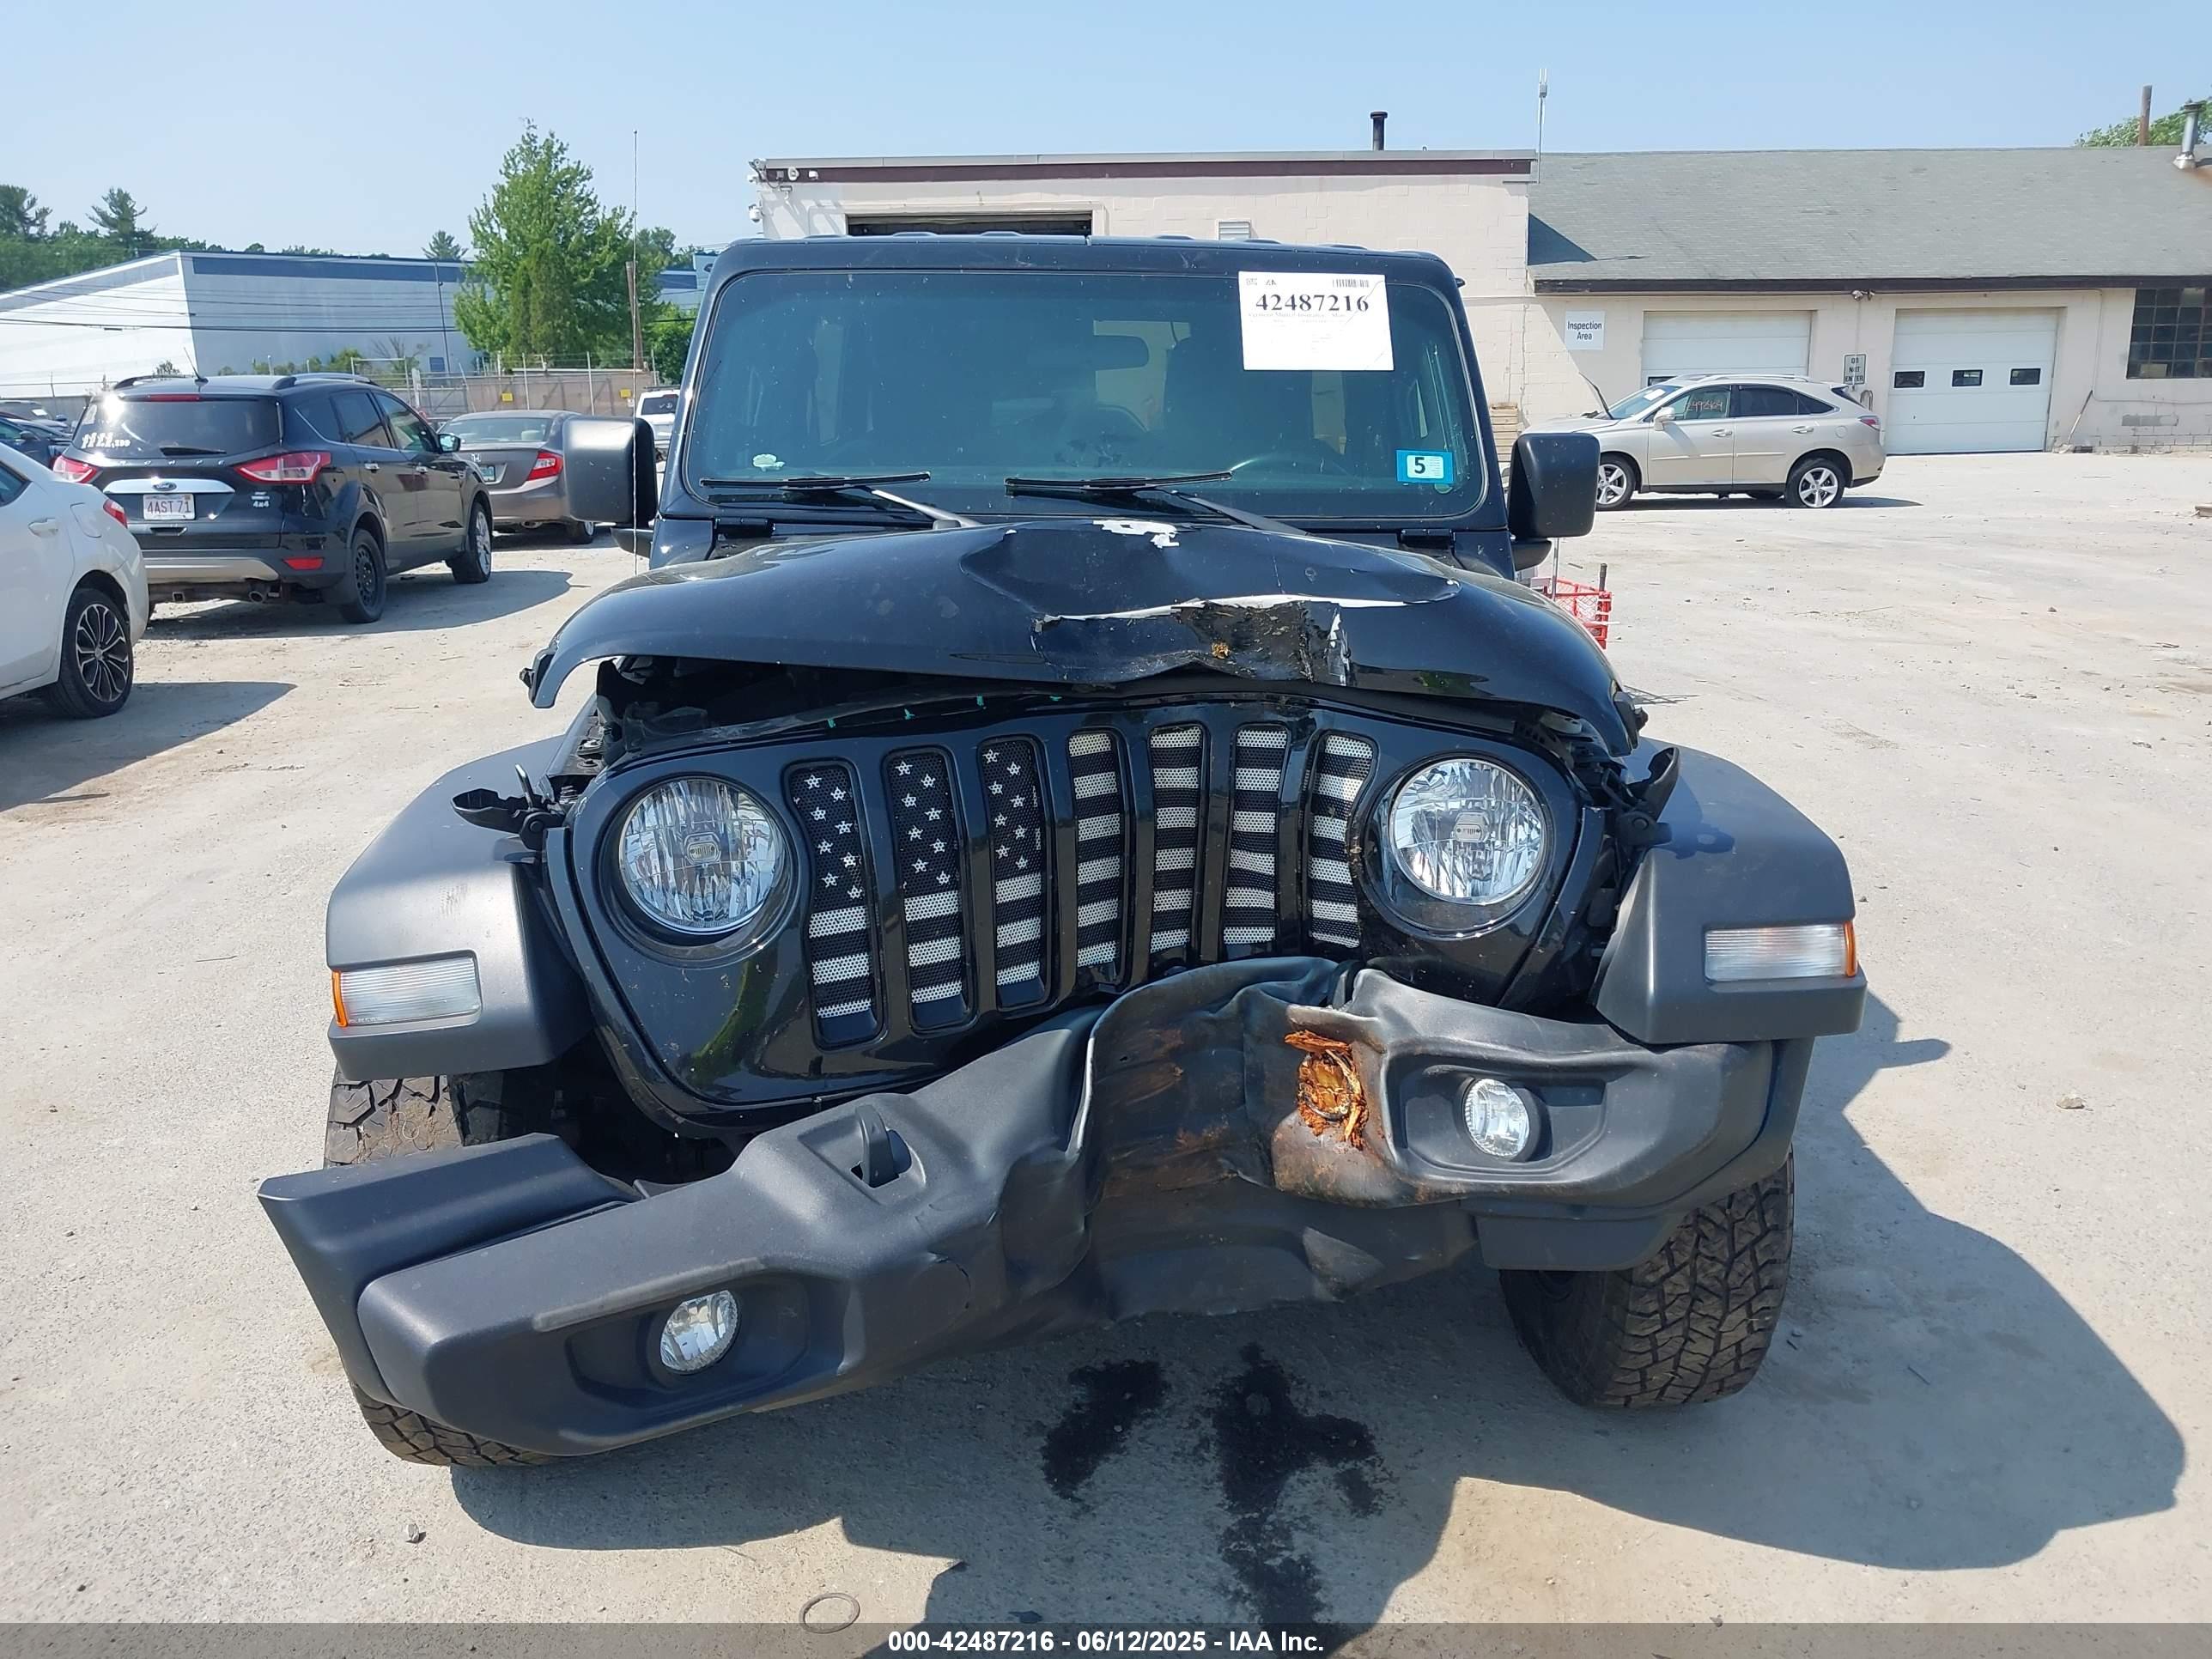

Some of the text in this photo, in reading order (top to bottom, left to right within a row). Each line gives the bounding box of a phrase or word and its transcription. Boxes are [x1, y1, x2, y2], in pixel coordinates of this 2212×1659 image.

[1255, 294, 1369, 312] 42487216
[1567, 320, 1602, 331] Inspection
[1577, 331, 1593, 341] Area
[1414, 457, 1425, 474] 5
[147, 501, 191, 514] 4AST 71
